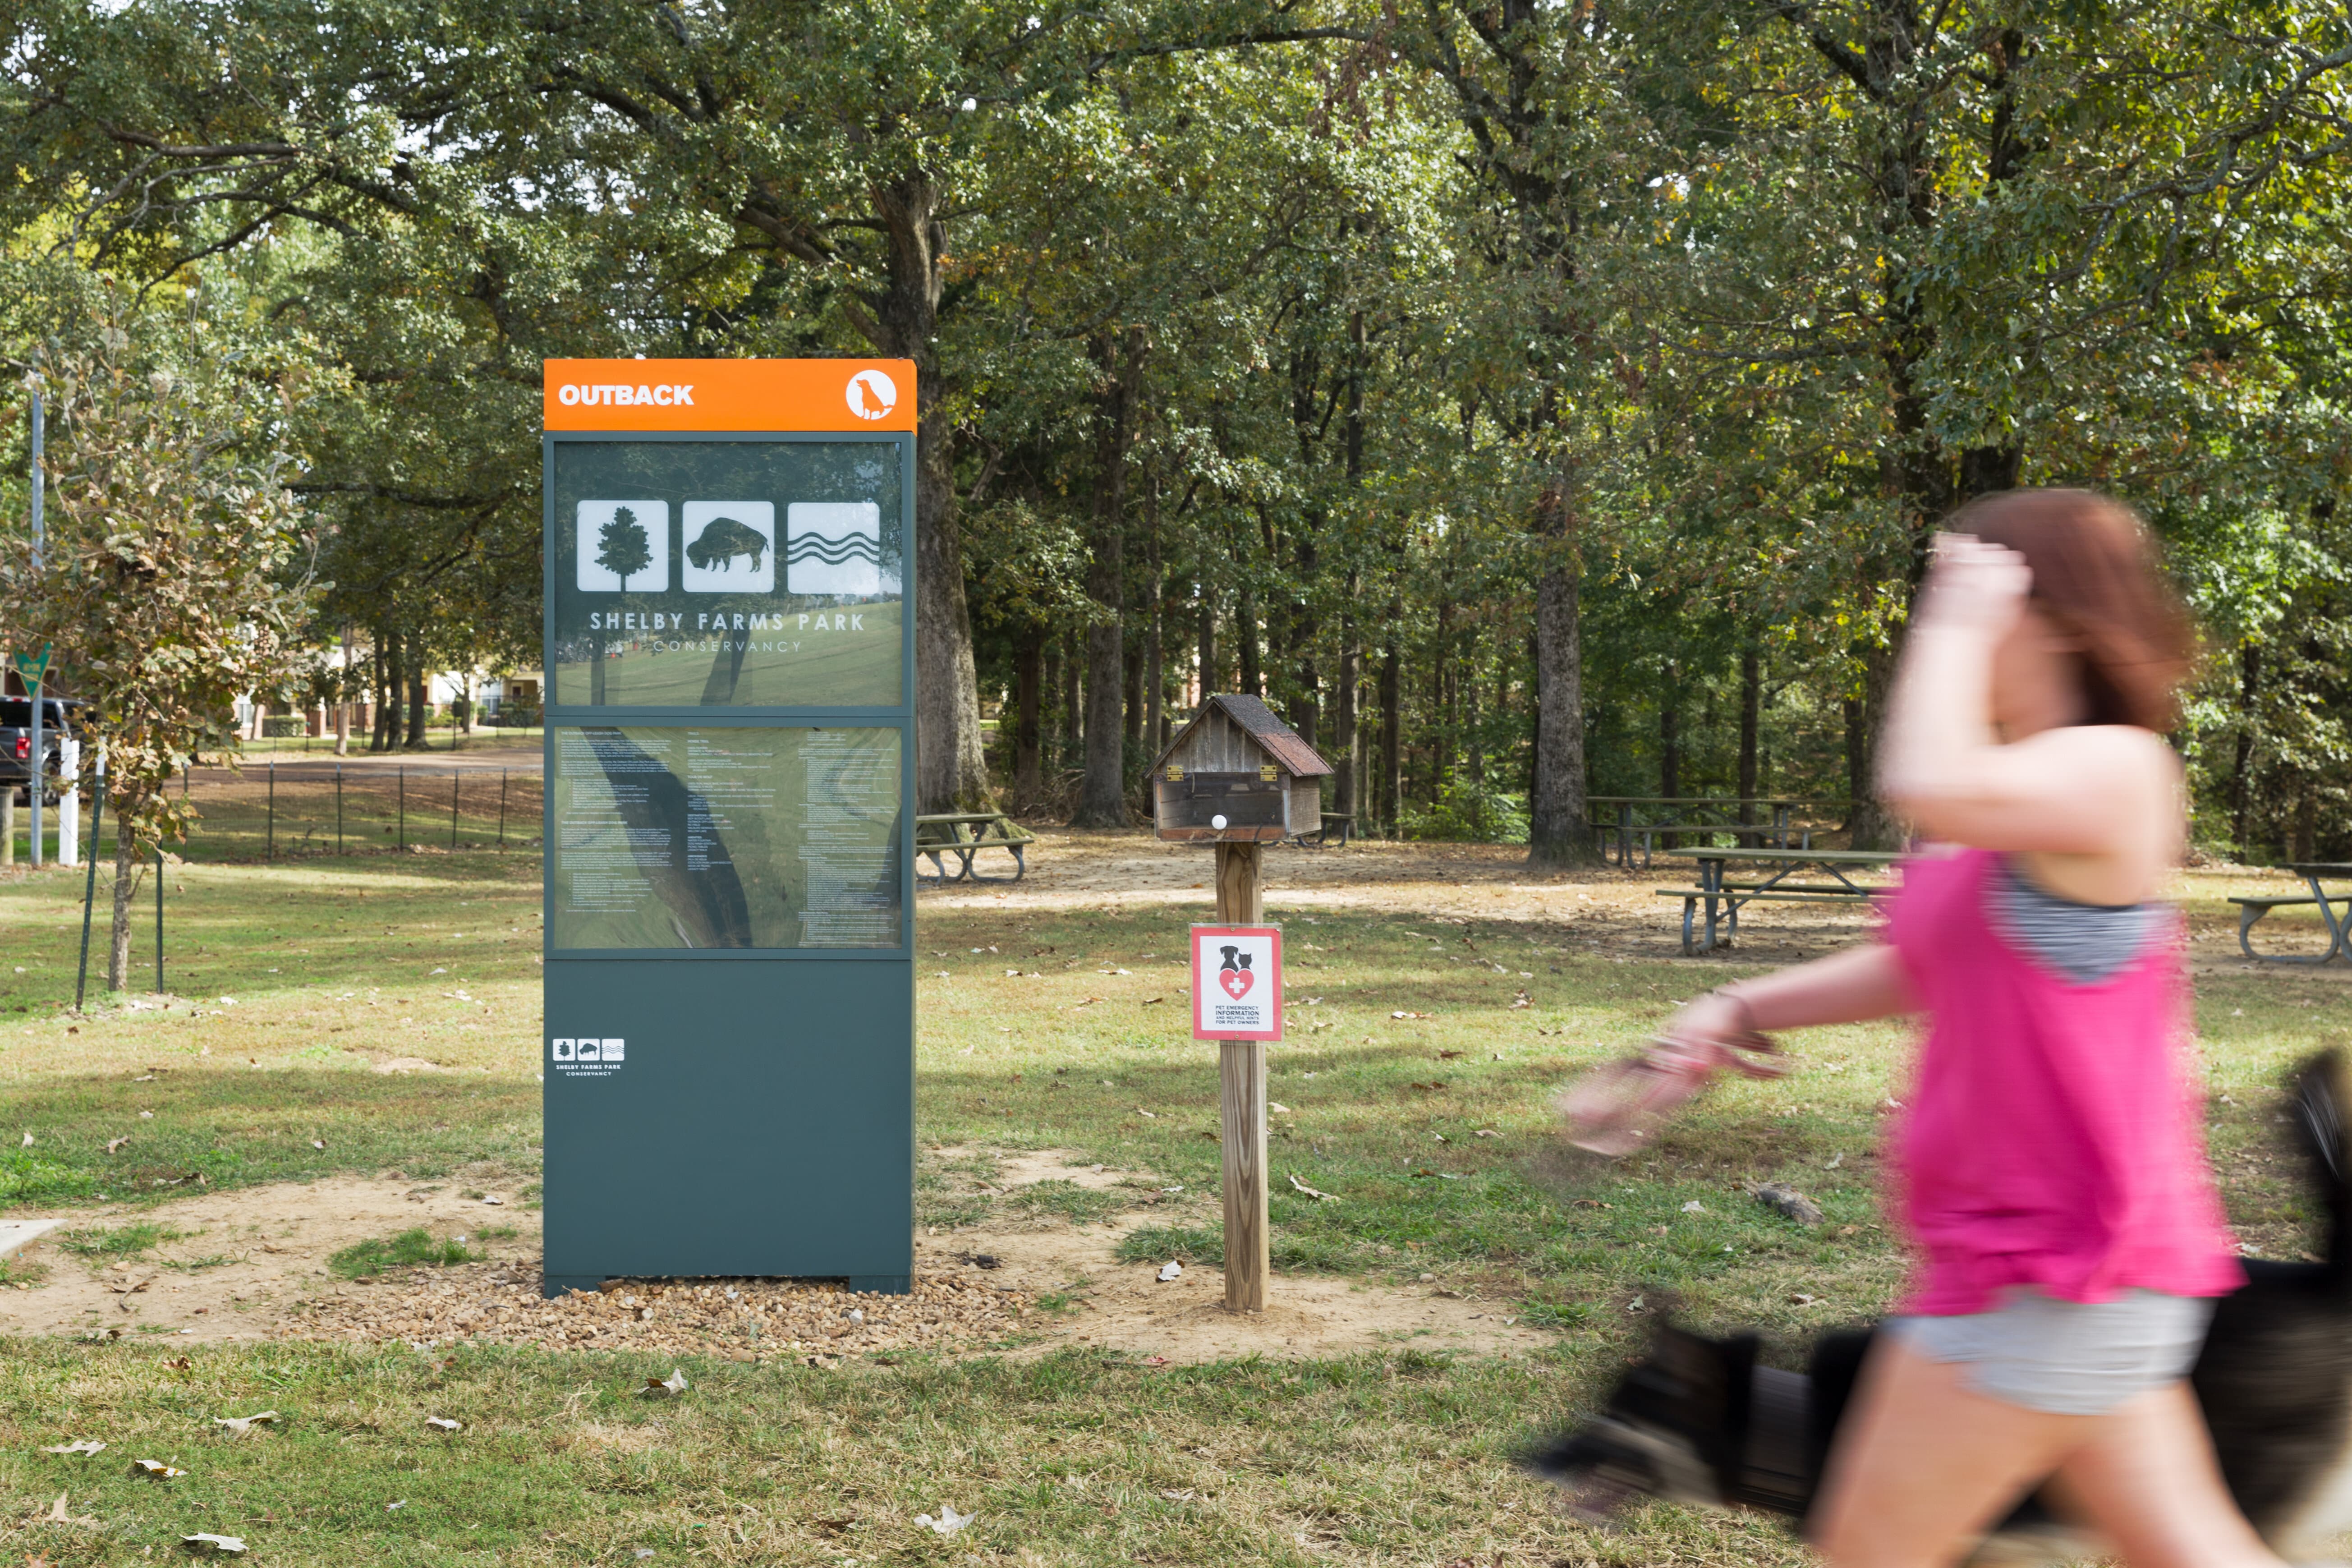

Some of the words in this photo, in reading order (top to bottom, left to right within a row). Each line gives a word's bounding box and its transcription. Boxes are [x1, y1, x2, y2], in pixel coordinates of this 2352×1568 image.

[559, 384, 695, 406] OUTBACK
[589, 612, 683, 630] SHELBY
[698, 612, 784, 631] FARMS
[799, 613, 865, 631] PARK
[652, 639, 802, 653] CONSERVANCY
